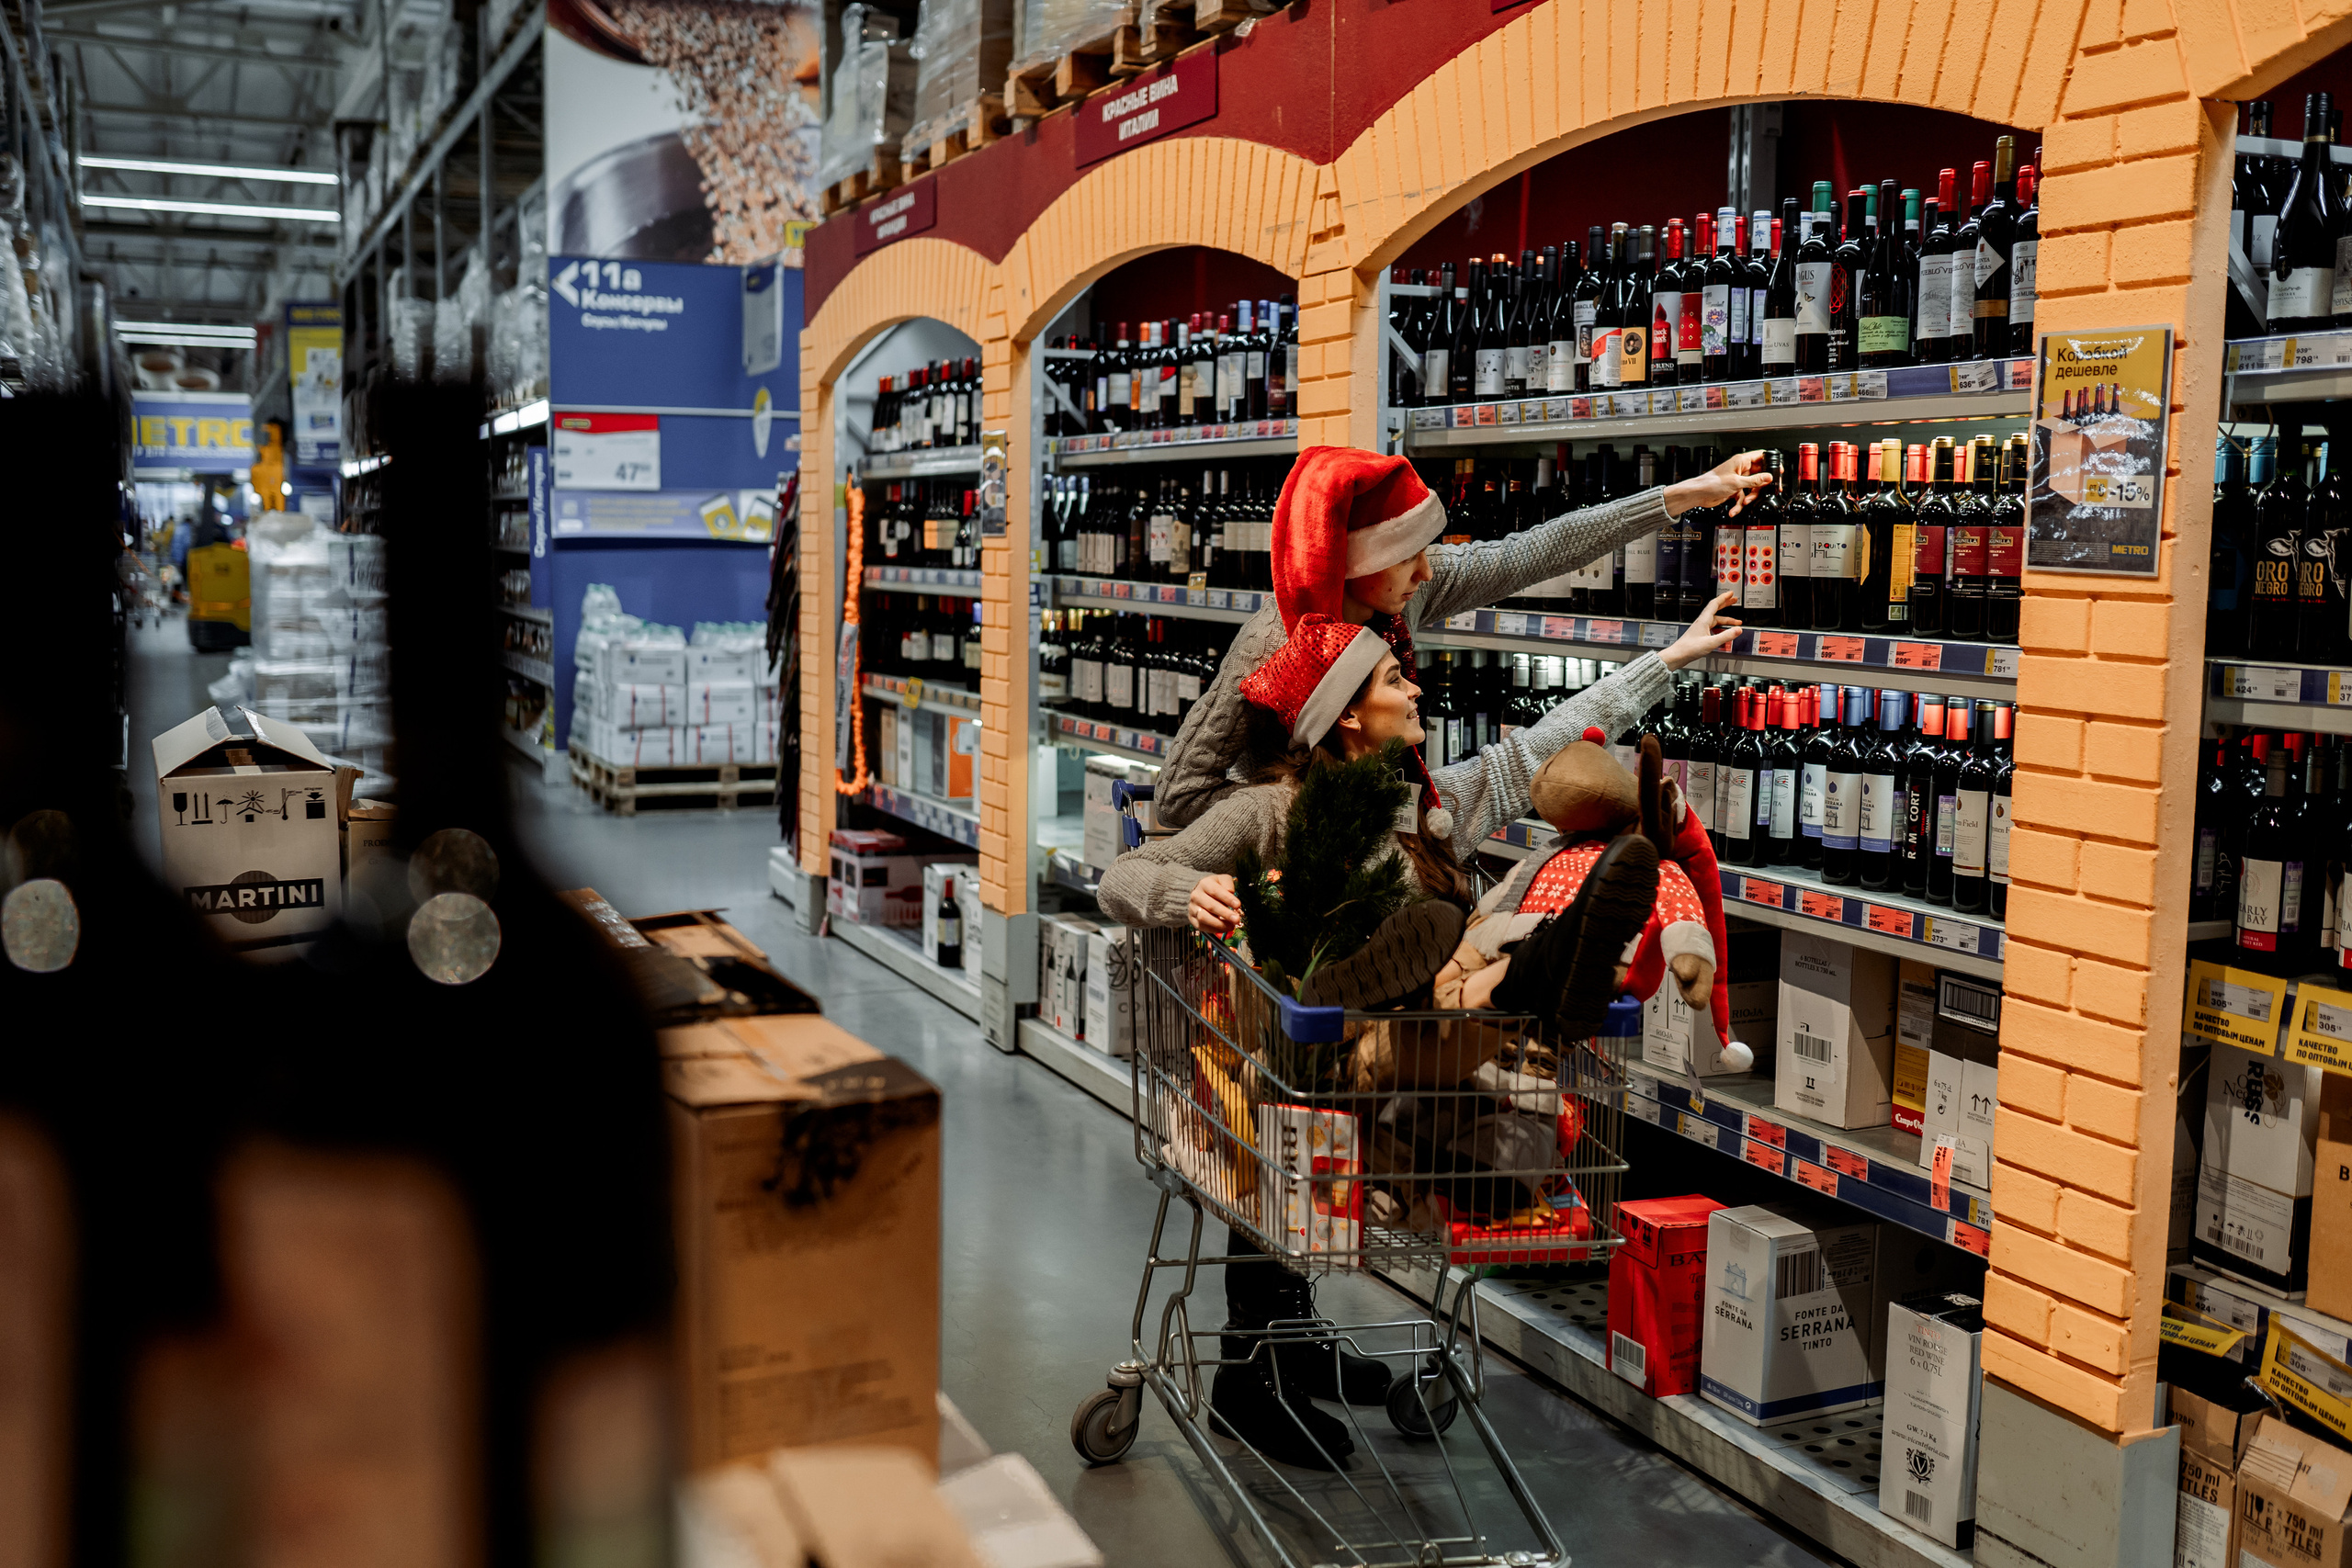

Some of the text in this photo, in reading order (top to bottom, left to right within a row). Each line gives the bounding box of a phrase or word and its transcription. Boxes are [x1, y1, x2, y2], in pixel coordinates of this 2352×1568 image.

[1102, 73, 1179, 122] КРАСНЫЕ ВИНА
[1118, 108, 1159, 141] ИТАЛИИ
[581, 288, 684, 316] Консервы
[2057, 344, 2128, 364] Коробкой
[2296, 355, 2313, 365] 798
[2055, 363, 2119, 380] дешевле
[615, 463, 639, 481] 47
[2112, 544, 2149, 556] METRO
[2256, 561, 2289, 582] ORO
[2255, 581, 2288, 595] NEGRO
[1962, 818, 1979, 829] Field
[190, 884, 318, 911] MARTINI
[1870, 919, 1881, 928] 399
[2246, 915, 2268, 926] BAY
[1931, 934, 1944, 943] 373
[2211, 998, 2227, 1008] 305
[2195, 1011, 2230, 1027] КАЧЕСТВО
[2318, 1021, 2336, 1032] 305
[2193, 1021, 2266, 1048] ПО ОПТОВЫМ ЦЕНАМ
[2299, 1038, 2337, 1055] КАЧЕСТВО
[2296, 1048, 2347, 1069] ПО ОПТОВЫМ
[1895, 1112, 1914, 1127] Campo
[1722, 1301, 1738, 1314] FONTE
[1795, 1303, 1844, 1321] FONTE DA
[2196, 1302, 2211, 1313] 424
[1714, 1305, 1753, 1331] SERRANA
[1781, 1315, 1856, 1341] SERRANA
[1917, 1325, 1941, 1340] TINTO
[1802, 1337, 1832, 1351] TINTO
[1907, 1333, 1948, 1356] VIN ROUGE
[2188, 1337, 2218, 1349] ЦЕНАМ
[1909, 1345, 1945, 1366] RED WINE
[1910, 1357, 1916, 1366] 6
[2290, 1357, 2306, 1372] 305
[2271, 1368, 2309, 1396] КАЧЕСТВО
[2269, 1377, 2346, 1430] ПО ОПТОВЫМ ЦЕНАМ
[2181, 1461, 2221, 1488] 750 ml
[2286, 1510, 2306, 1532] 750
[2309, 1526, 2324, 1541] ml
